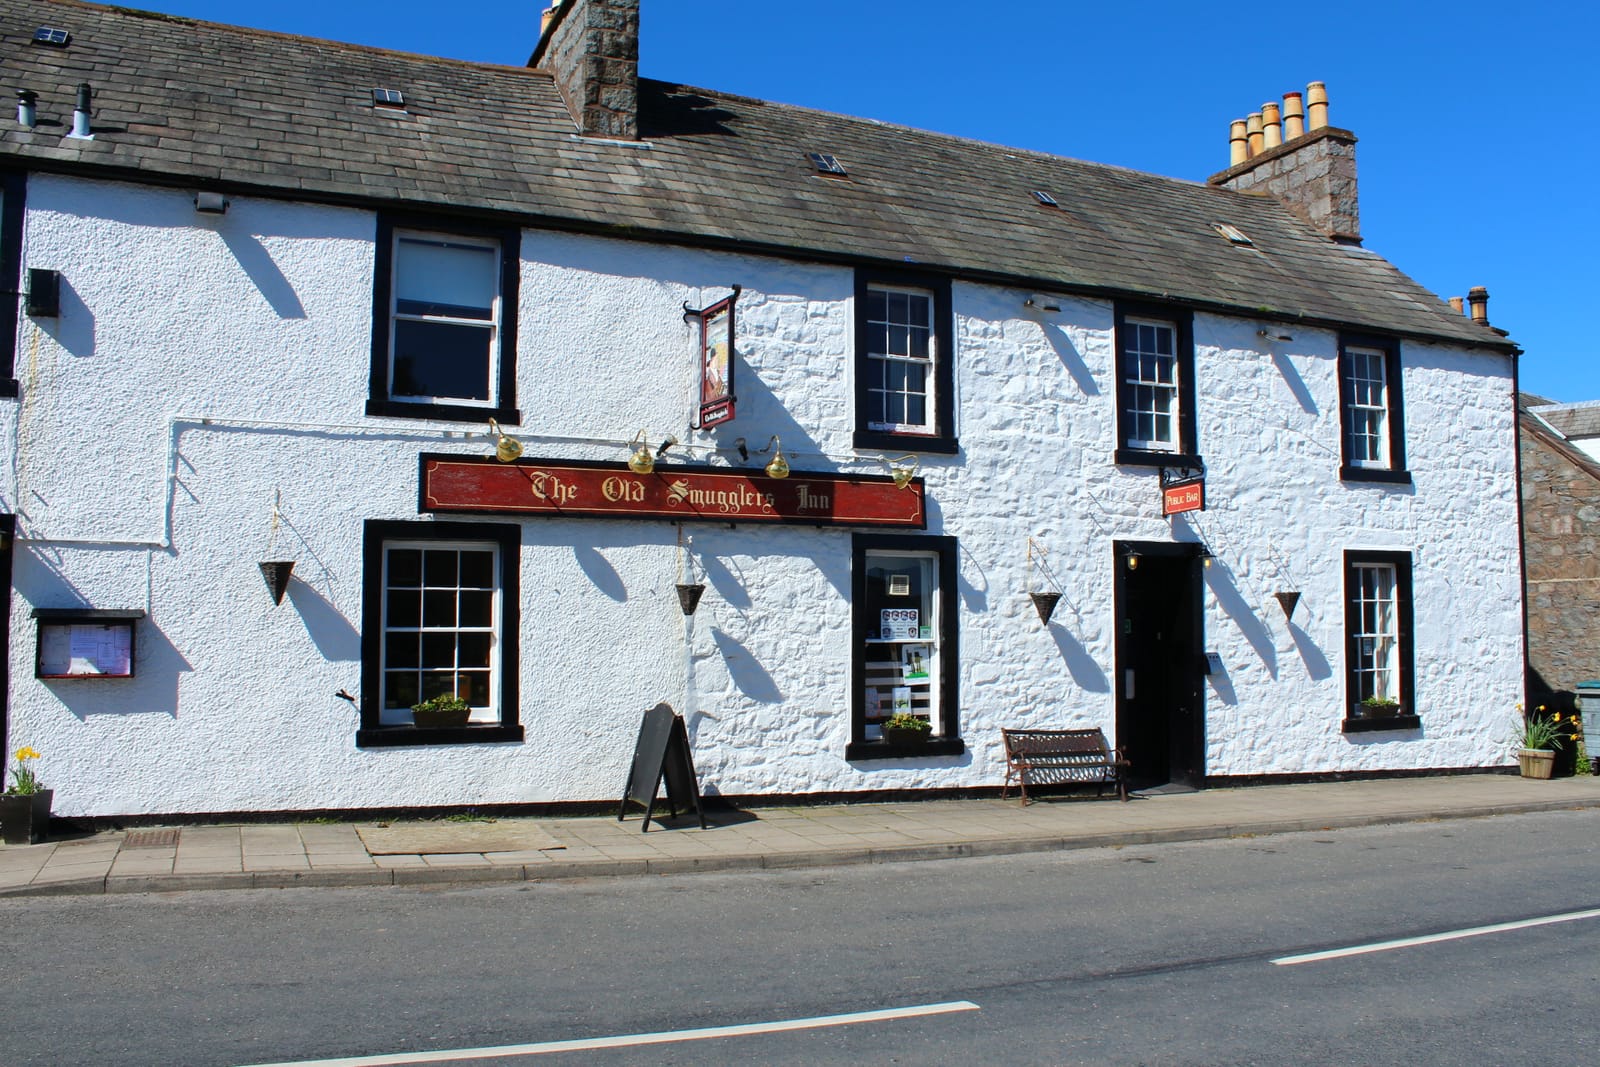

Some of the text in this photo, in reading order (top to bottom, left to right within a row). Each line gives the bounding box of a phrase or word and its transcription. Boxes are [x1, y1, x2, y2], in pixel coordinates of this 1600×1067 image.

[530, 471, 829, 513] The Old Smugglers Inn
[1167, 492, 1198, 506] PUBLIC BAR
